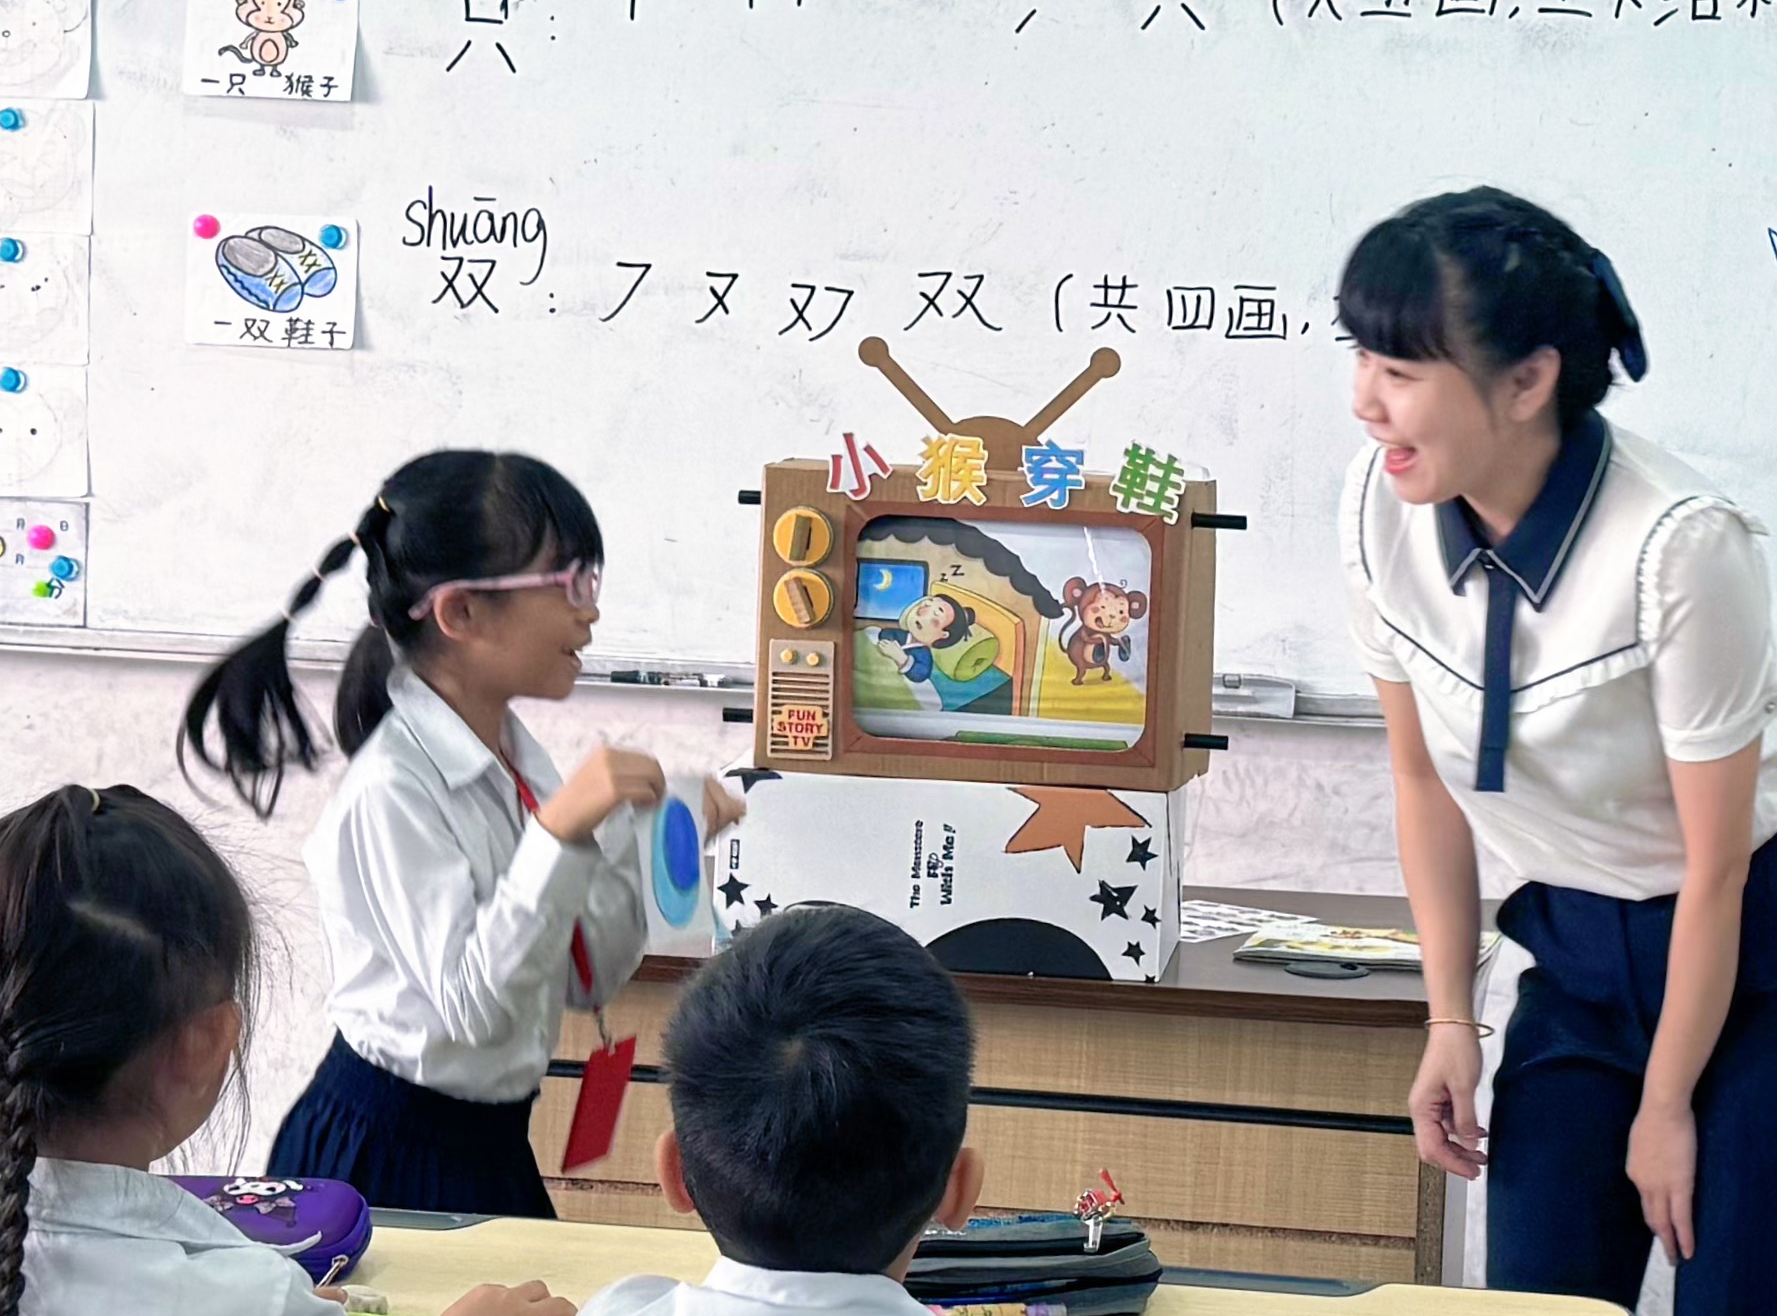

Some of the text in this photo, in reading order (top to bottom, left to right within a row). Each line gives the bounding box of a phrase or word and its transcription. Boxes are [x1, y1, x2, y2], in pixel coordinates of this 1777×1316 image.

[829, 432, 1184, 525] 小猴穿鞋
[787, 709, 817, 721] FUN
[776, 721, 824, 734] STORY
[792, 735, 811, 747] TV
